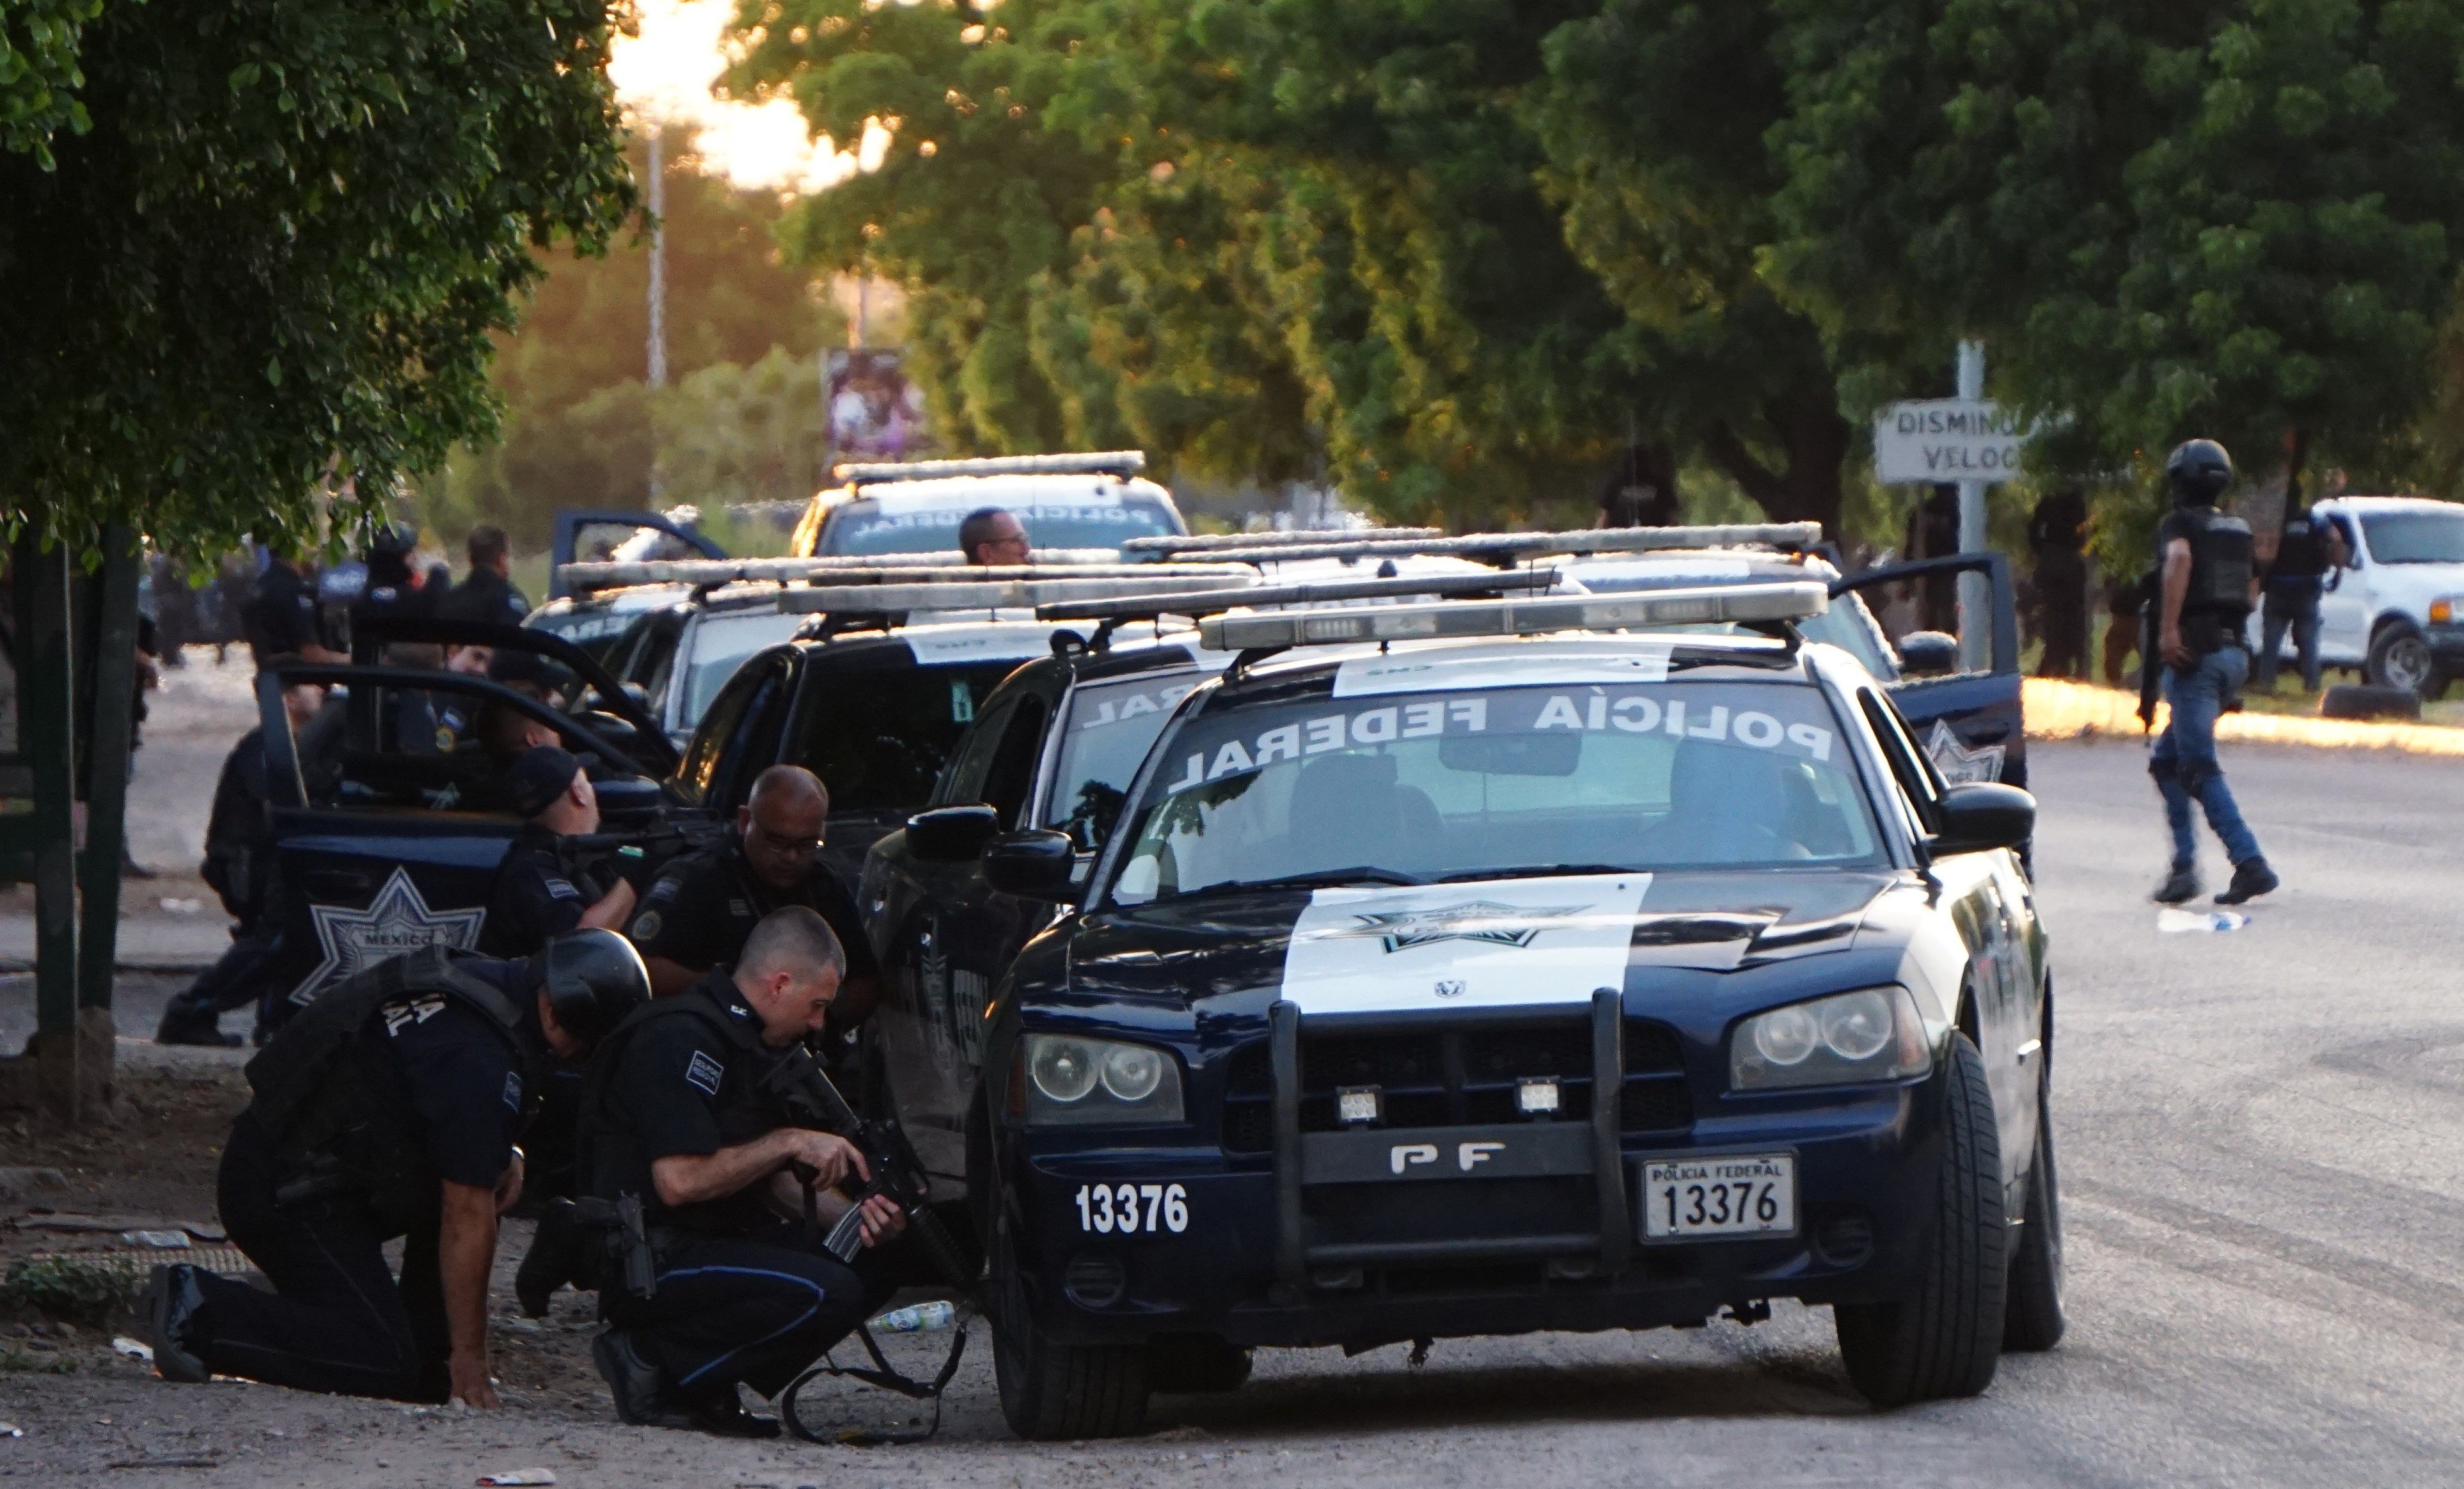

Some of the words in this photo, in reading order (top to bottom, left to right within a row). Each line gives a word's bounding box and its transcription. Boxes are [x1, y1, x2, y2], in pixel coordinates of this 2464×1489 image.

[1923, 445, 2016, 470] VELOC
[1075, 1183, 1189, 1234] 13376
[1664, 1181, 1778, 1227] 13376
